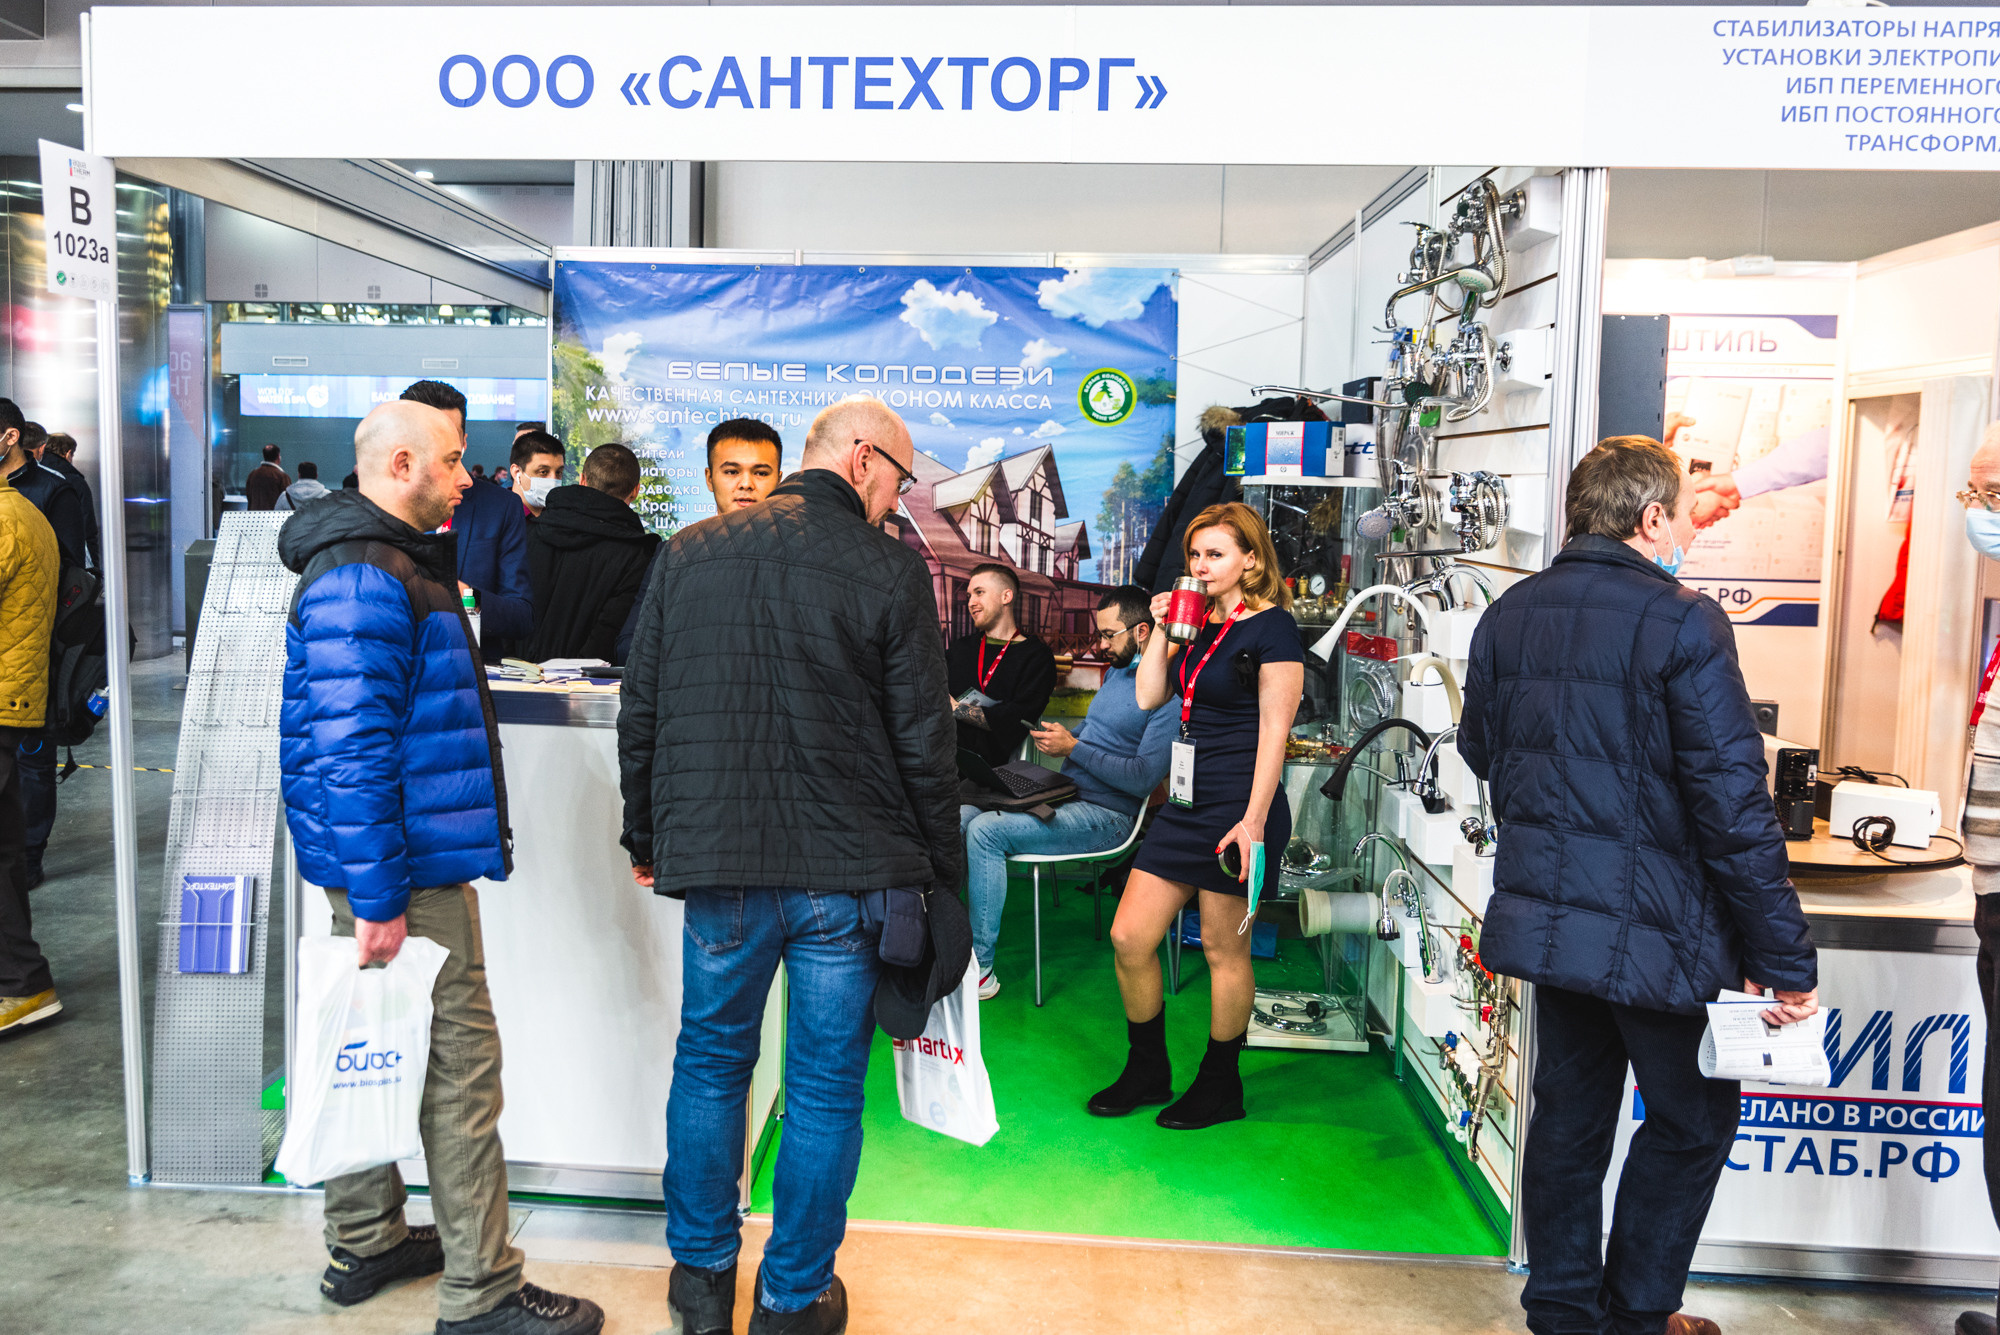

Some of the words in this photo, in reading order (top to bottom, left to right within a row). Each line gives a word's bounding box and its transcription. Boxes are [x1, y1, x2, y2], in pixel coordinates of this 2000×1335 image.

[1713, 20, 1917, 38] СТАБИЛИЗАТОРЫ
[1923, 20, 2000, 38] НАПРЯ
[1722, 48, 1862, 66] УСТАНОВКИ
[438, 53, 595, 109] ООО
[620, 55, 1169, 112] «САНТЕХТОРГ»
[1786, 77, 1834, 95] ИБП
[1840, 77, 2000, 96] ПЕРЕМЕННОГ
[1780, 105, 1829, 123] ИБП
[1845, 133, 2000, 153] ТРАНСФОРМ
[69, 185, 93, 227] B
[53, 230, 110, 265] 1023a
[667, 360, 808, 383] БЕЛЫЕ
[826, 363, 1054, 387] КОЛОДЕЗИ
[584, 385, 723, 404] КАЧЕСТВЕННАЯ
[729, 389, 848, 406] САНТЕХНИКА
[856, 387, 963, 409] КОНОМ
[968, 394, 1053, 410] КЛАССА
[1344, 441, 1376, 457] tt
[640, 498, 689, 515] Краны
[1843, 1103, 1861, 1127] В
